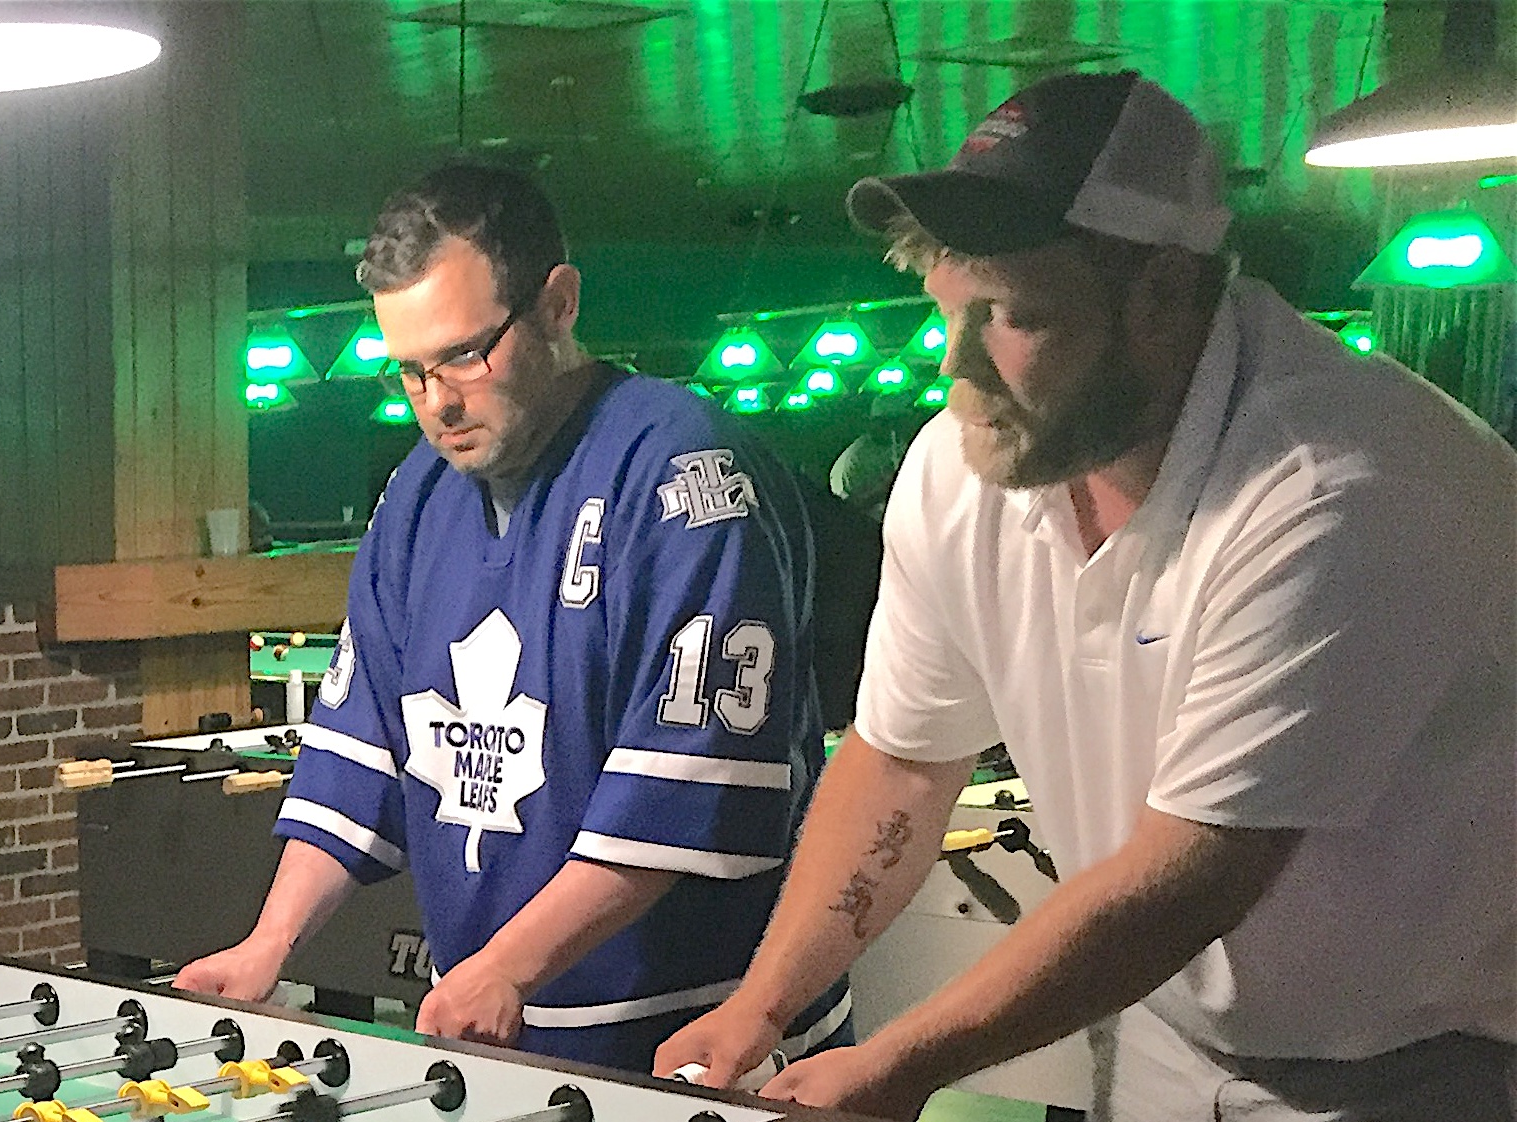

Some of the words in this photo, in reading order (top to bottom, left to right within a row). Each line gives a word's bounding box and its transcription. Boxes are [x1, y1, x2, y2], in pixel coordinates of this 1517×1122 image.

[559, 497, 606, 609] C
[656, 614, 776, 736] 13
[429, 721, 525, 754] TOROTO
